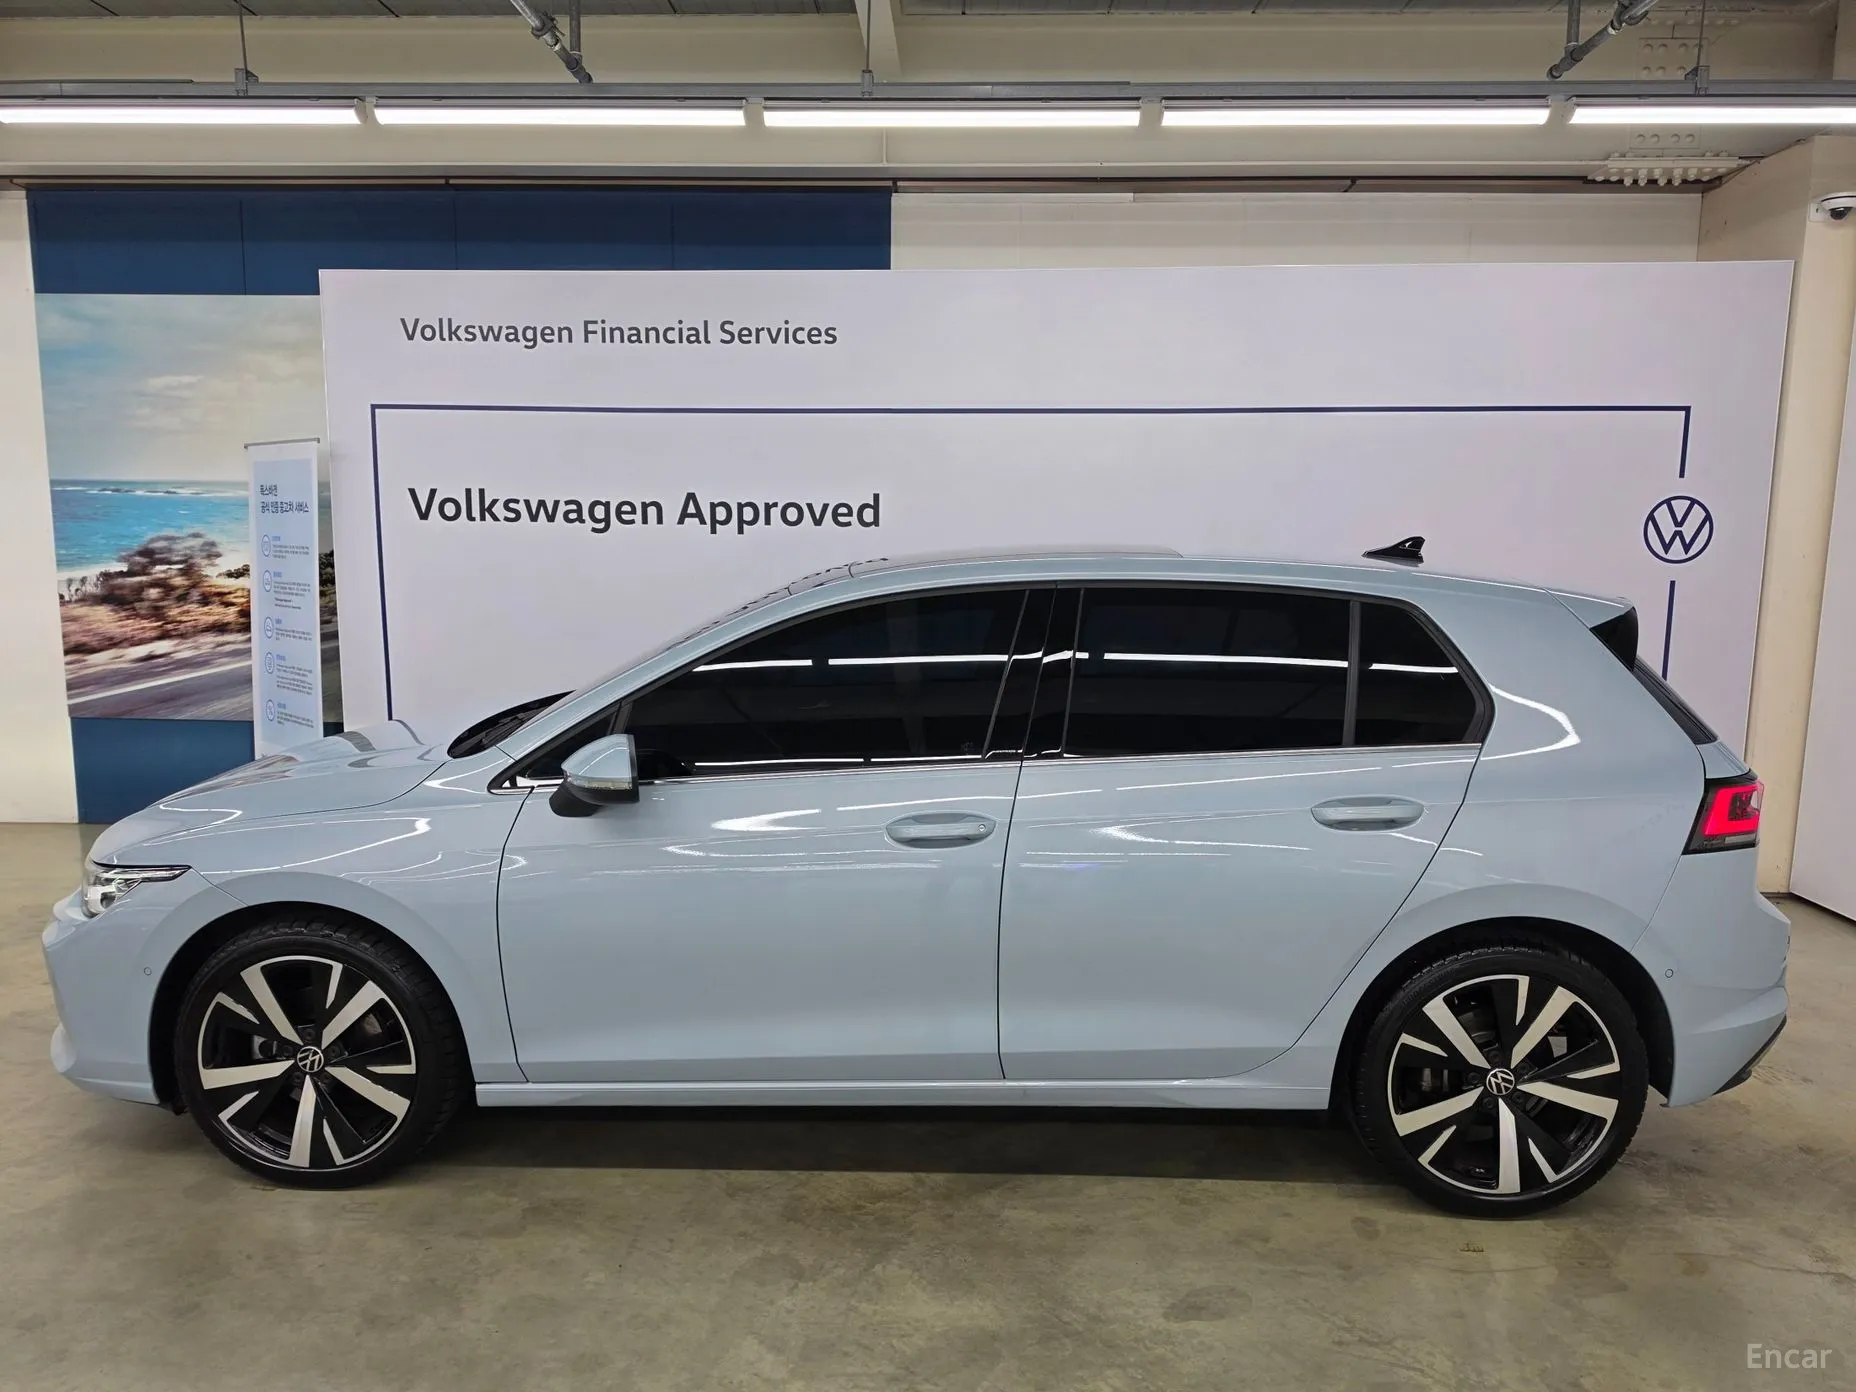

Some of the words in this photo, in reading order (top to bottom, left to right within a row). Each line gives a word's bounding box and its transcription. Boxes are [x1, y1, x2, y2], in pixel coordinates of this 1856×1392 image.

[400, 318, 573, 349] Volkswagen
[583, 319, 711, 345] Financial
[719, 320, 838, 345] Services
[408, 488, 664, 534] Volkswagen
[676, 491, 880, 535] Approved
